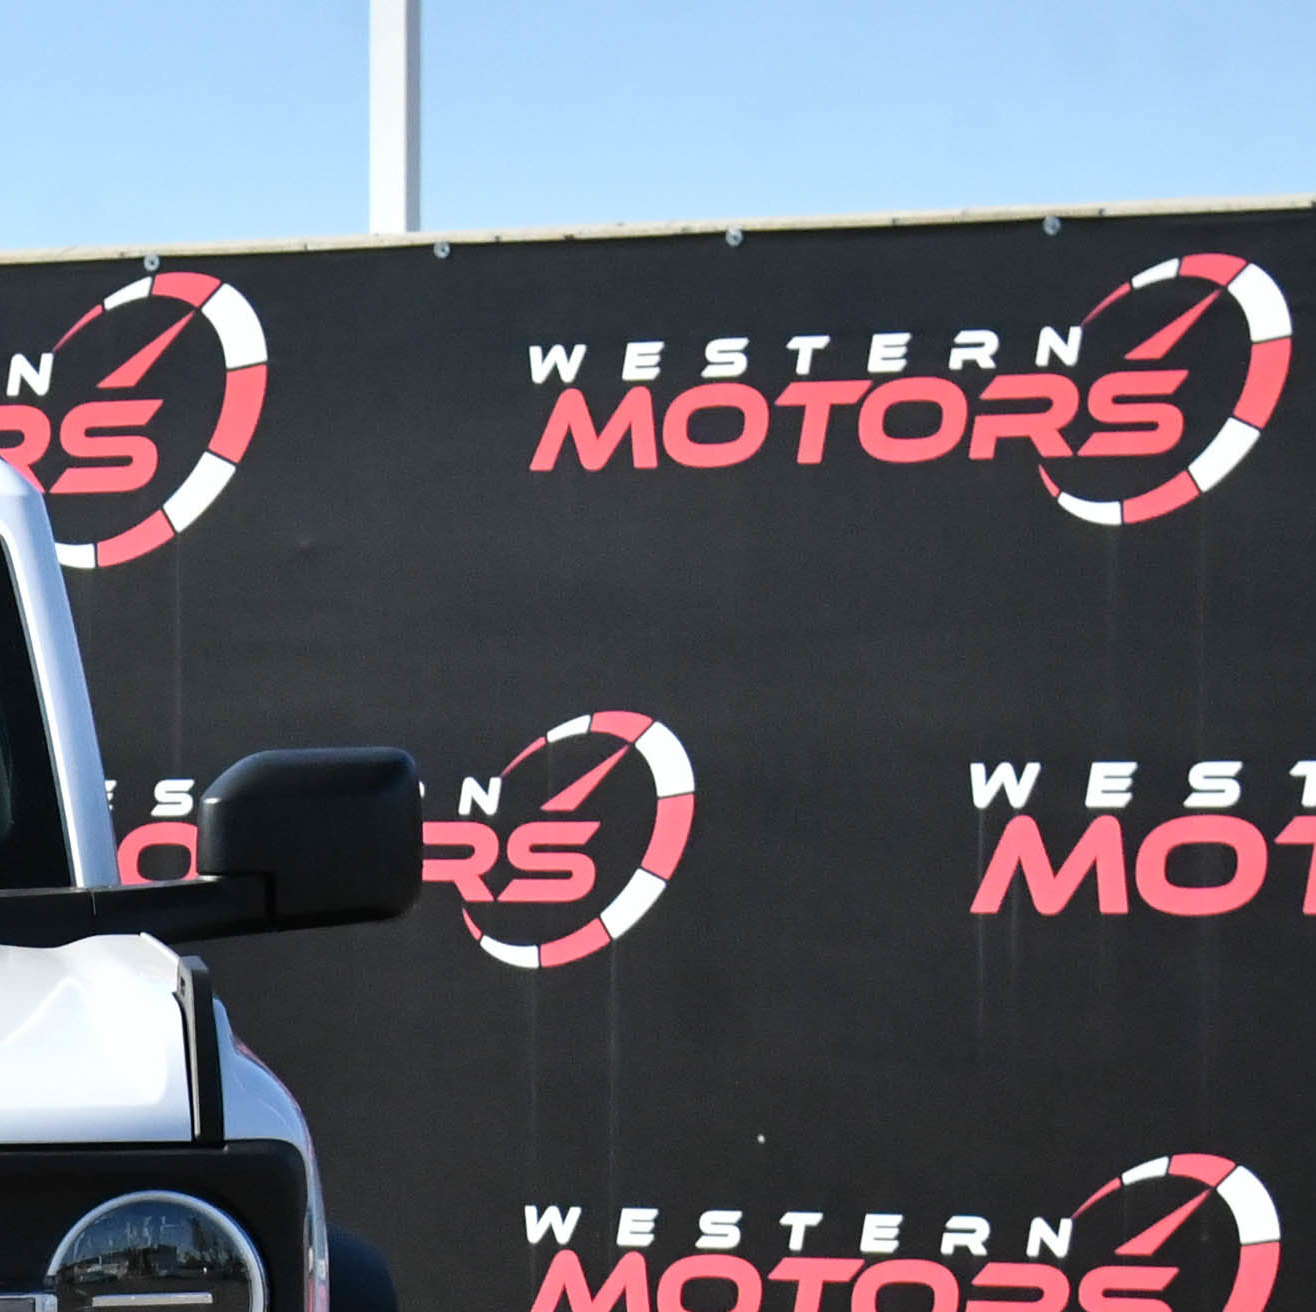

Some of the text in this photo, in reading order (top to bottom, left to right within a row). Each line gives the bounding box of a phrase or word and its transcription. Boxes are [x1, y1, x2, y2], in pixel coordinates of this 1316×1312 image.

[529, 326, 1083, 383] WESTERN
[529, 368, 1189, 472] MOTORS
[524, 1205, 1073, 1257] WESTERN
